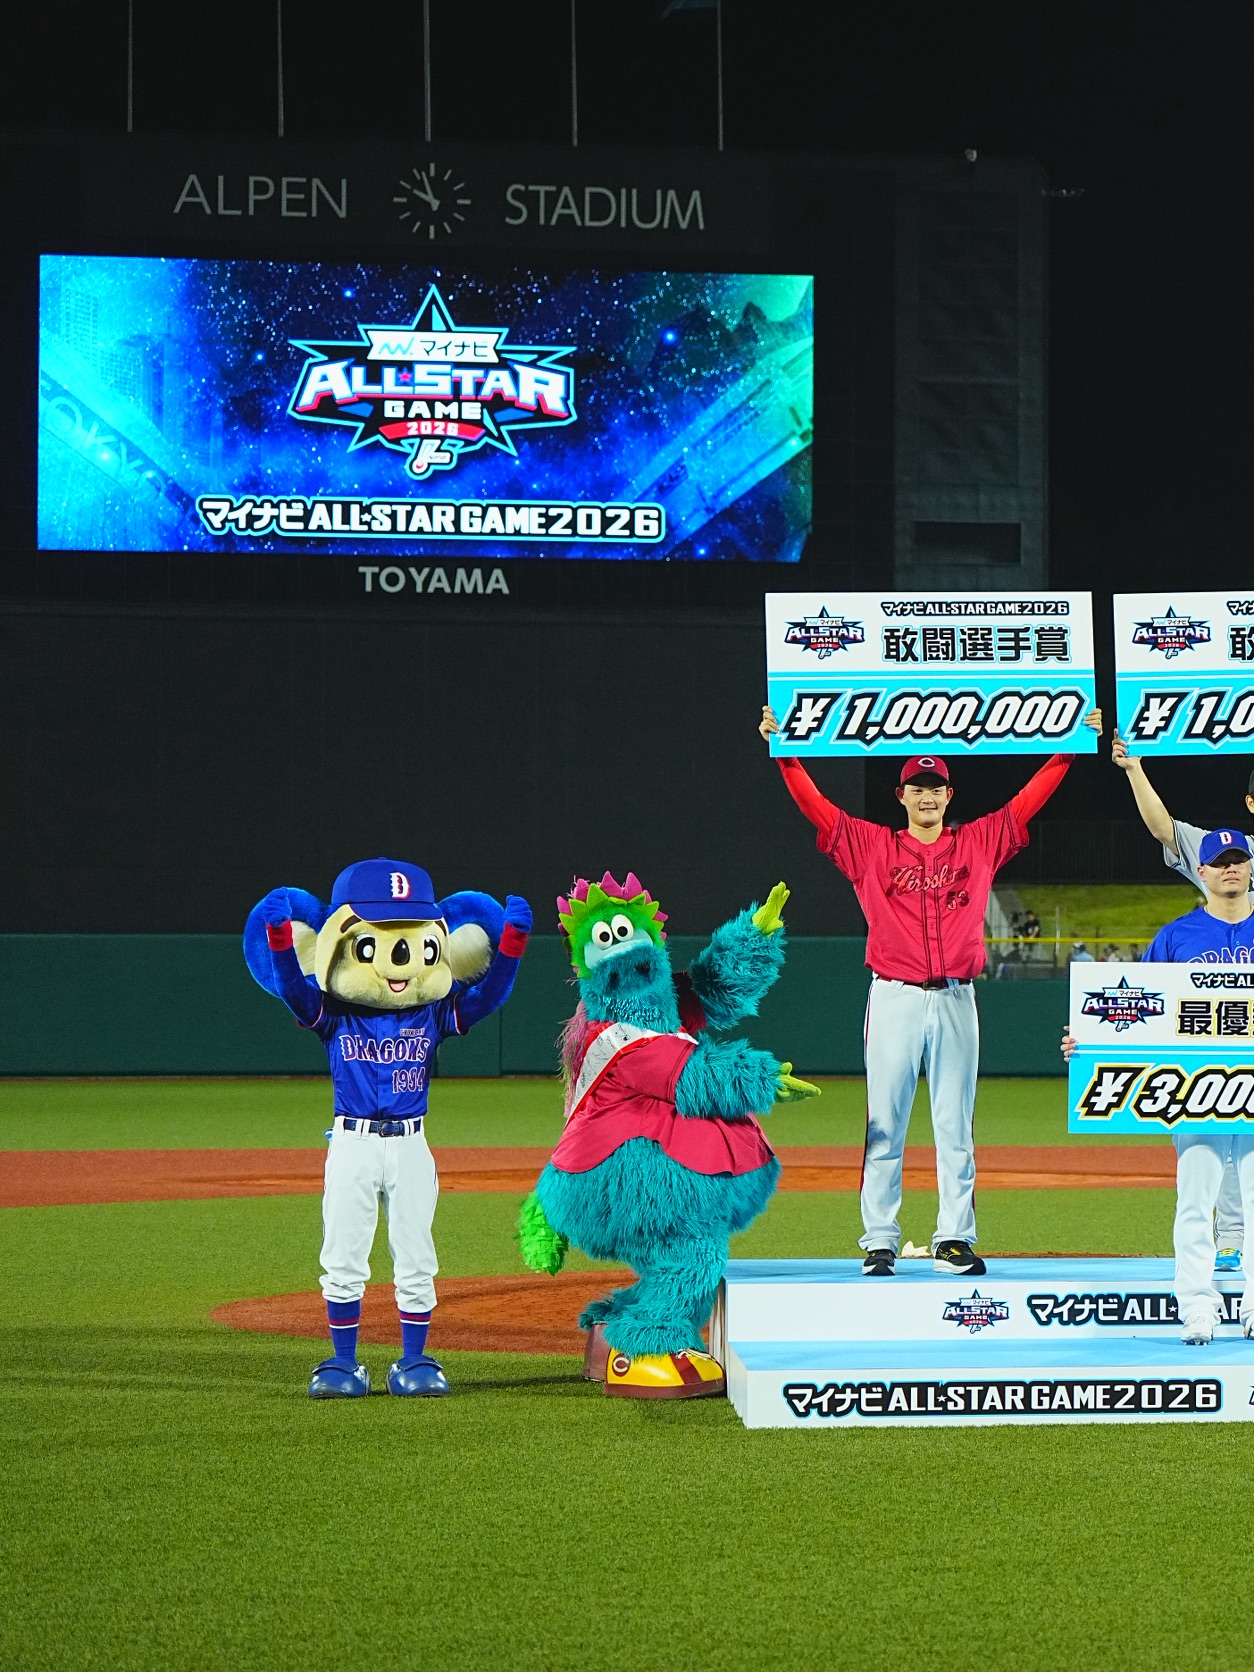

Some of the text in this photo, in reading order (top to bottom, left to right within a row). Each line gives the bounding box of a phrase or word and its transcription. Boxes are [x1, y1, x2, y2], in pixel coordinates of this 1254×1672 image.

[173, 173, 705, 230] ALPEN STADIUM
[420, 340, 488, 357] マイナビ
[384, 400, 481, 419] GAME
[406, 421, 459, 436] 2026
[358, 566, 510, 595] TOYAMA
[883, 626, 1071, 662] 敢闘選手賞
[1219, 831, 1233, 845] D
[389, 872, 410, 899] D
[886, 864, 970, 897] Hiroshima
[946, 890, 970, 910] 53
[340, 1035, 430, 1064] DRAGONS
[392, 1067, 425, 1094] 1994
